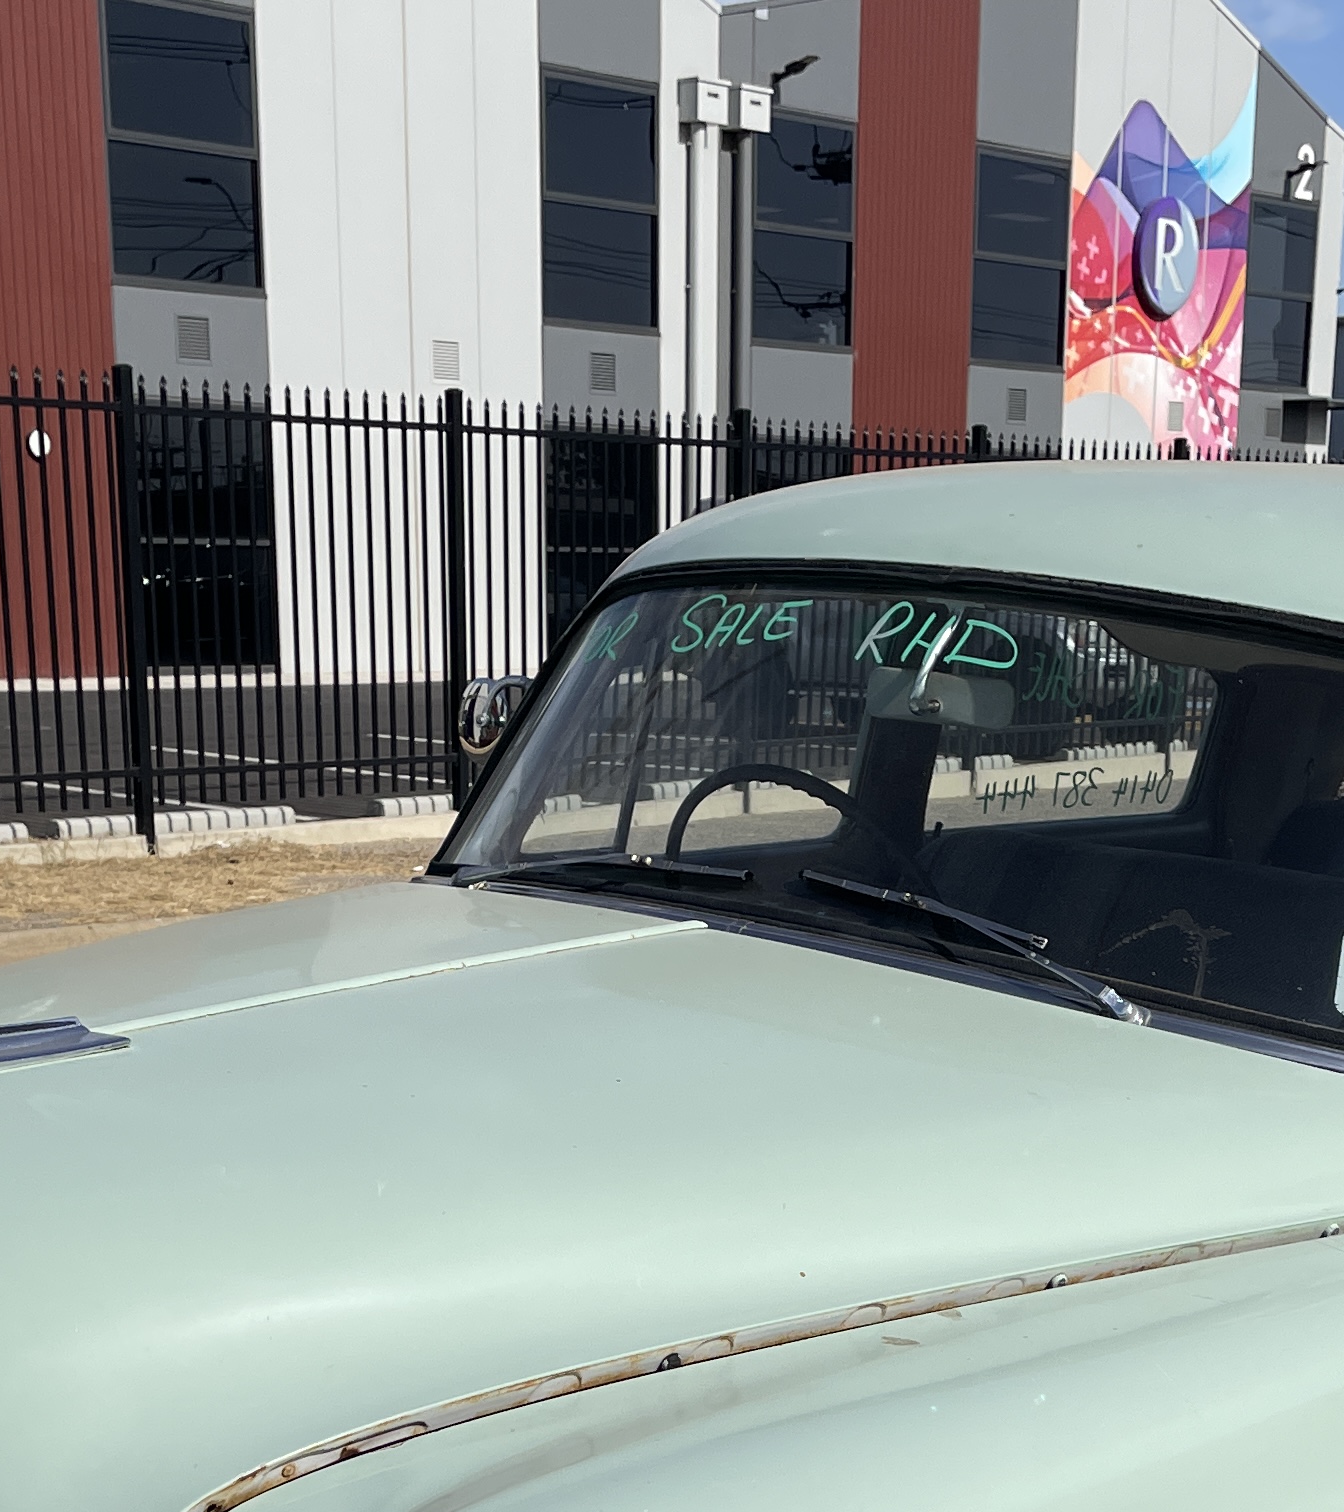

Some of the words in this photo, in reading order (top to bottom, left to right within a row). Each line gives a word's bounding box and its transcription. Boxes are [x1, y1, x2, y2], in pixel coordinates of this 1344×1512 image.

[1294, 143, 1315, 201] 2
[1154, 216, 1185, 293] R
[584, 611, 639, 663] OR
[671, 594, 813, 653] SALE
[855, 601, 1018, 668] RHD
